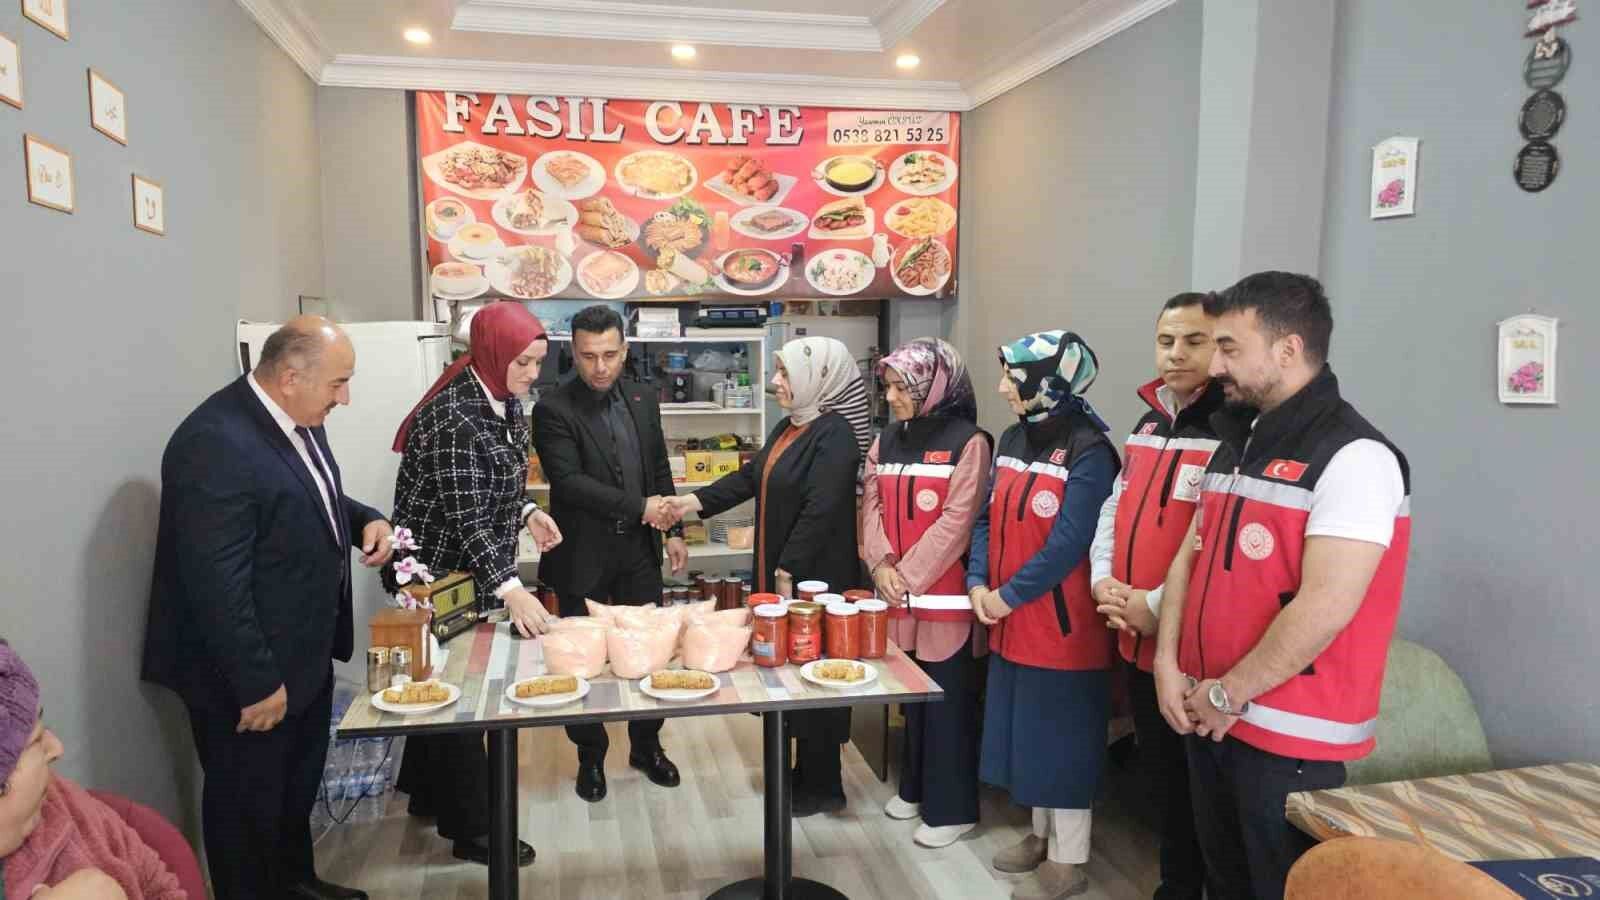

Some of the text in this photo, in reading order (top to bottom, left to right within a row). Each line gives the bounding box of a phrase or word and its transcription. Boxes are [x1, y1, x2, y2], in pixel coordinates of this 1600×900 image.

[442, 91, 803, 146] FASIL CAFE
[833, 127, 944, 143] 0538 821 53 25
